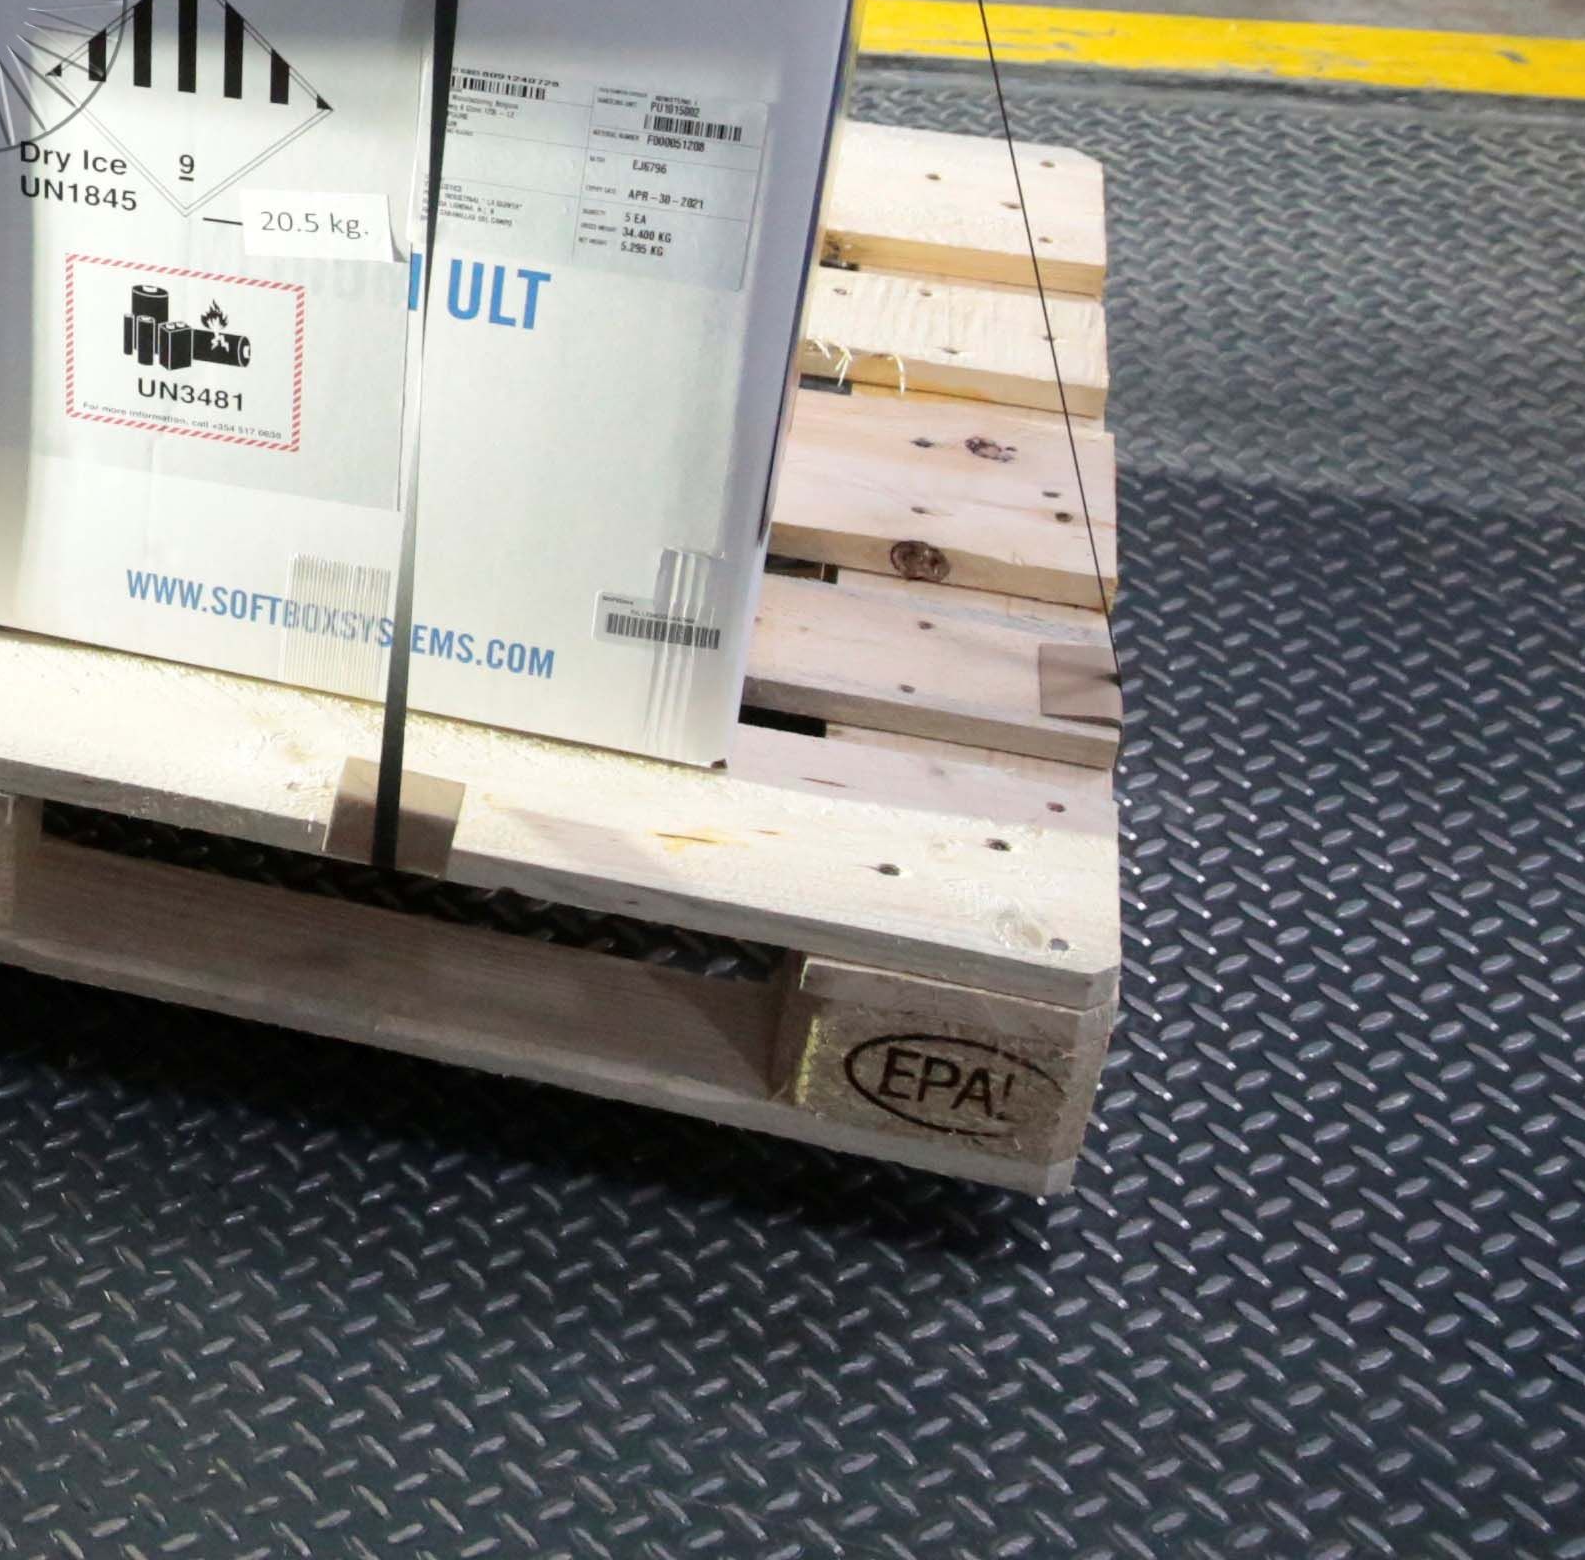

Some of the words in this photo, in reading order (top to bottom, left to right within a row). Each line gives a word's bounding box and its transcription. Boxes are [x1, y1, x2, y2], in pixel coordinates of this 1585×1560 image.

[20, 142, 71, 173] Dry
[83, 150, 128, 175] Ice
[179, 154, 195, 175] 9
[20, 175, 137, 212] UN1845
[260, 210, 320, 234] 20.5
[329, 212, 370, 241] kg.
[658, 231, 672, 243] KG
[650, 244, 664, 257] KG
[446, 258, 552, 330] ULT
[137, 377, 244, 412] UN3481
[102, 405, 127, 416] more
[192, 418, 209, 429] call
[127, 569, 555, 679] WWW.SOFTBOXSYSEMS.COM
